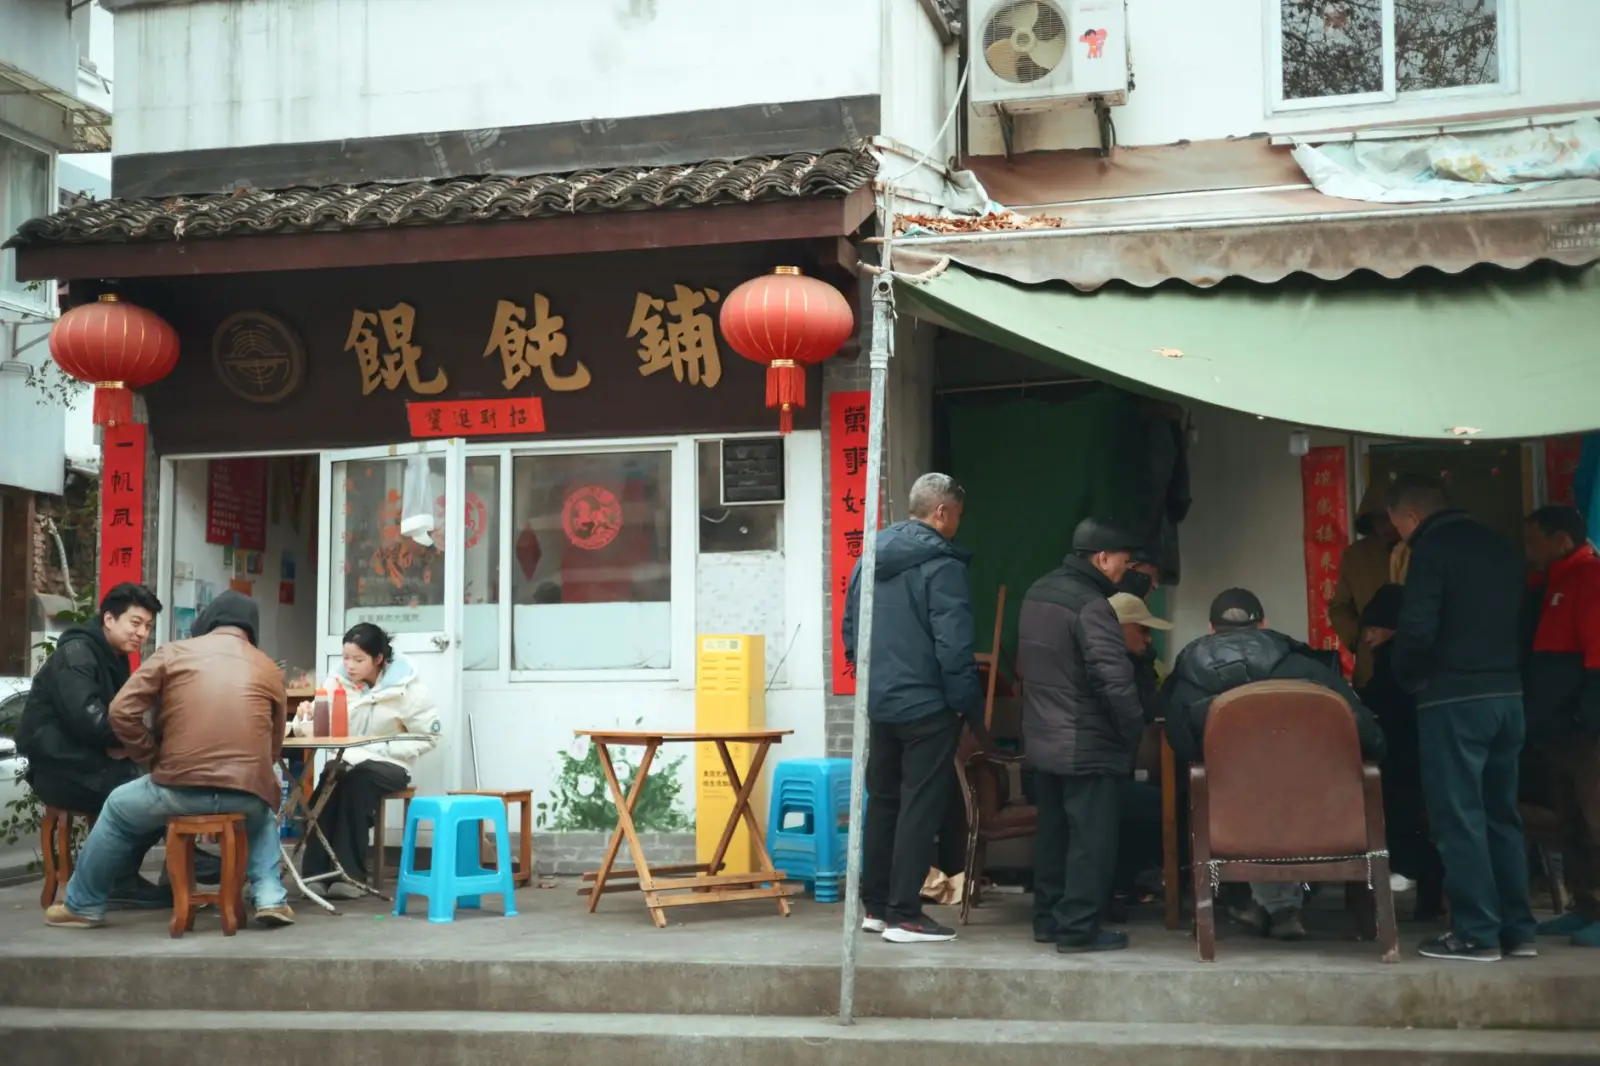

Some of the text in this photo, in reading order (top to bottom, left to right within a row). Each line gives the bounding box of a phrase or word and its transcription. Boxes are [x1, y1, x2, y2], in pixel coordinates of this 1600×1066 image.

[344, 283, 723, 397] 餛飩鋪
[109, 441, 134, 568] 一帆風順
